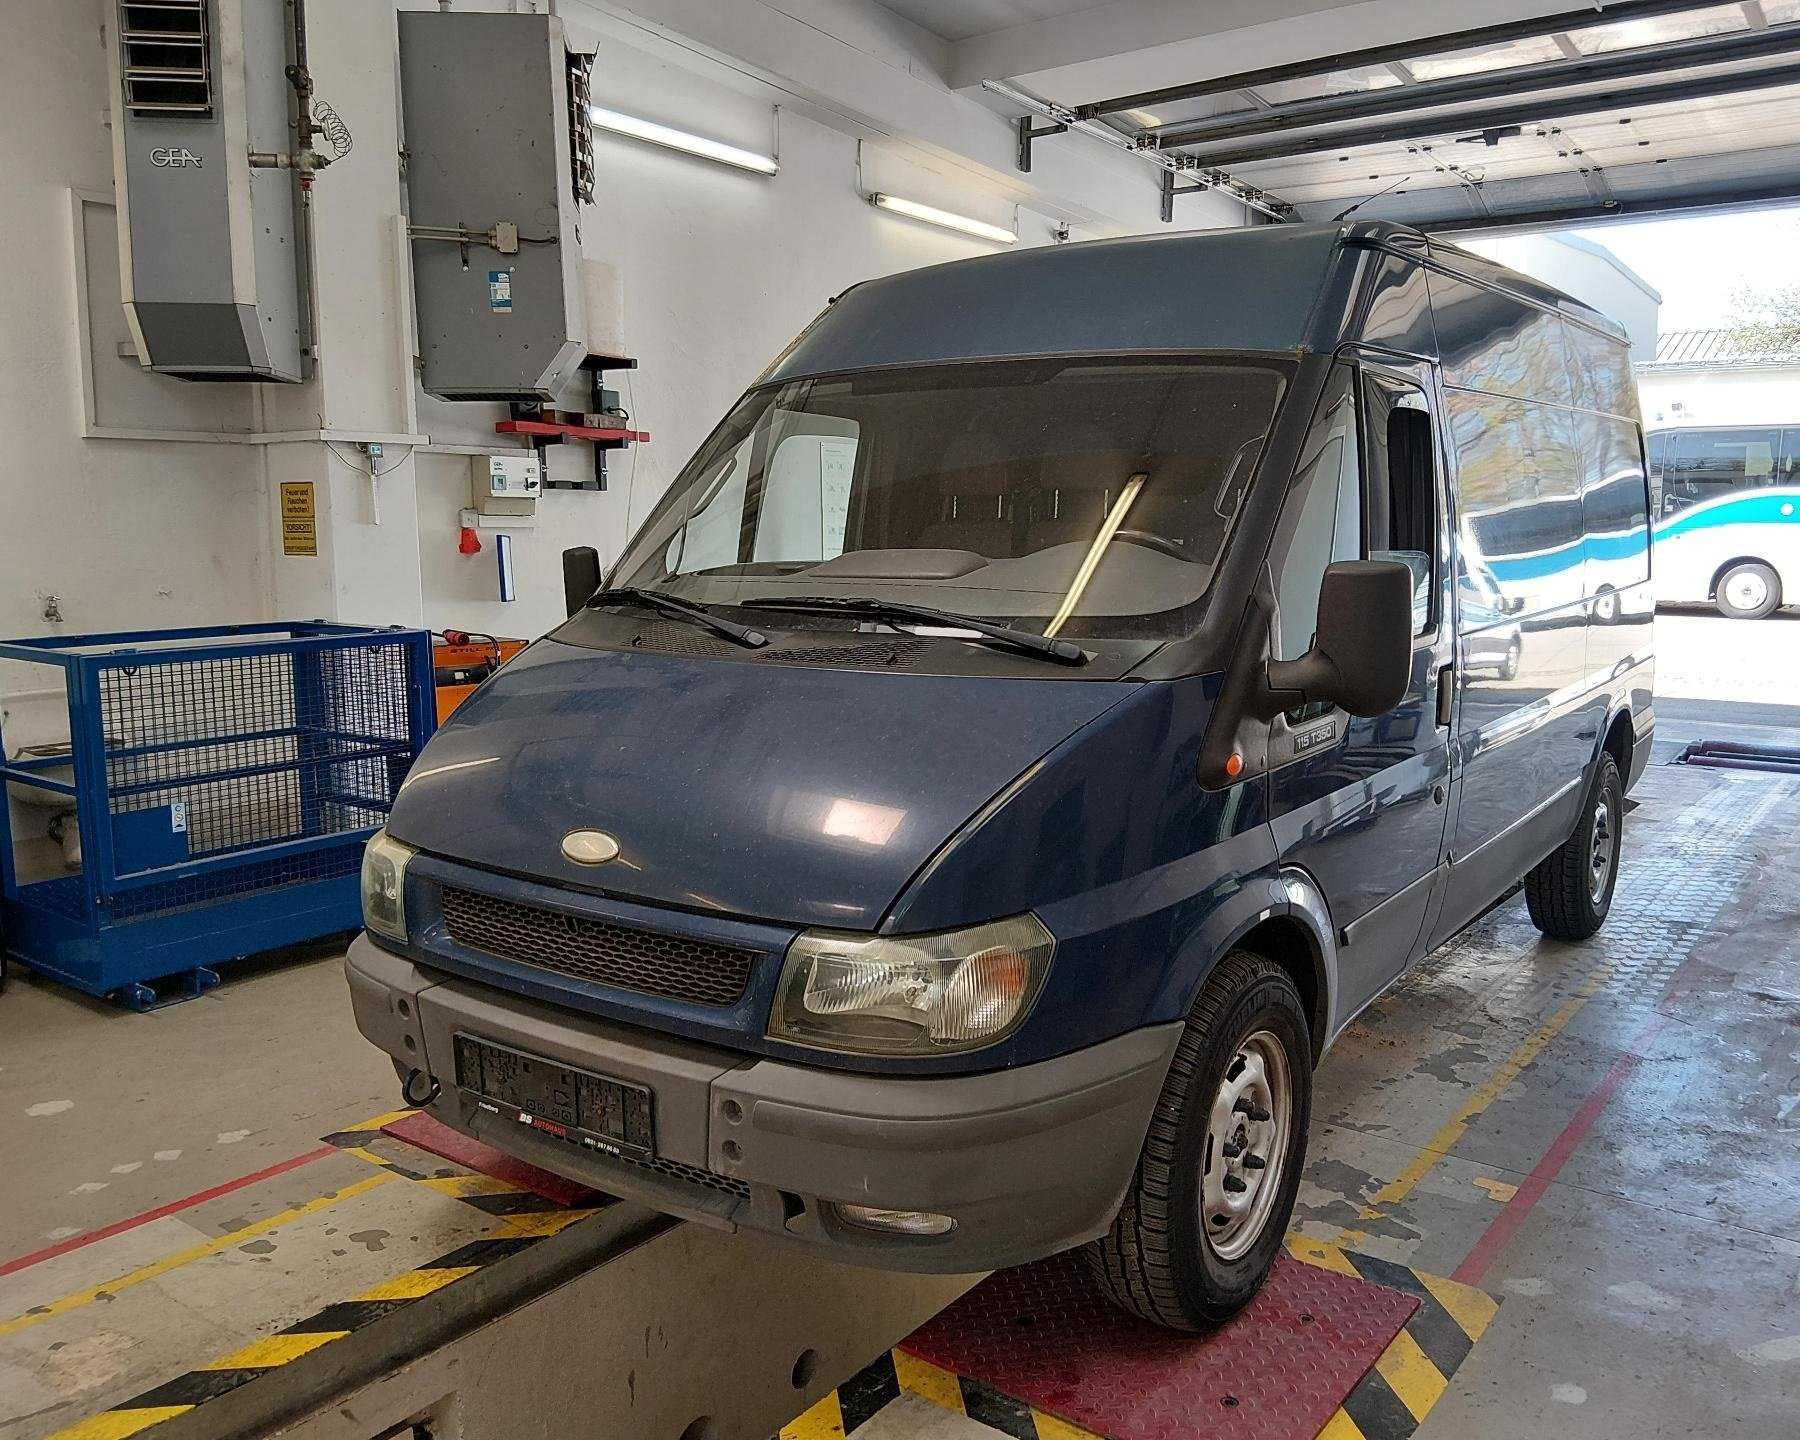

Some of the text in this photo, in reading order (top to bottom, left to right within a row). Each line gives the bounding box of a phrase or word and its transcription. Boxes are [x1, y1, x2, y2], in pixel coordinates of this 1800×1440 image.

[150, 147, 202, 168] GEA
[1297, 726, 1331, 749] 115 T350
